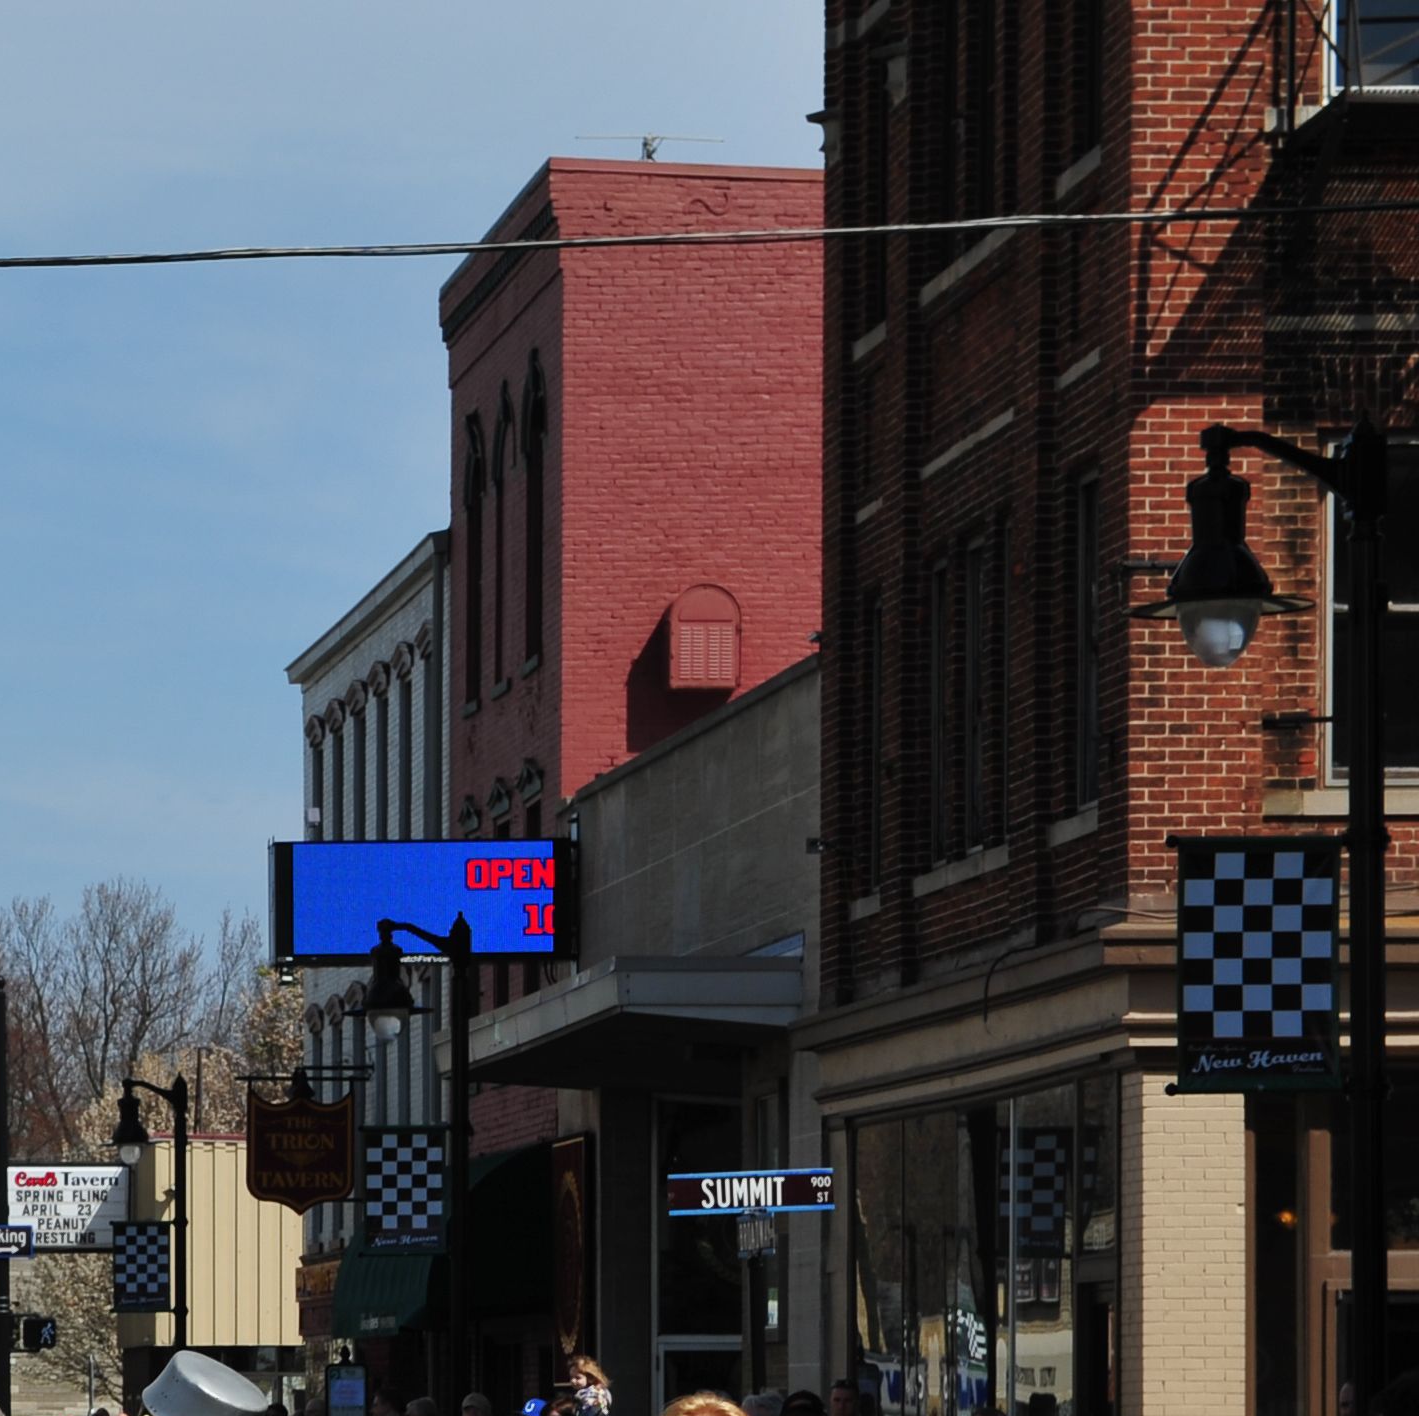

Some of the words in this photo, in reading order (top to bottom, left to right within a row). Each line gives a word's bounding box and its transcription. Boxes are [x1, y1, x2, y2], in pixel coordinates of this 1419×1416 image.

[466, 858, 555, 890] OPEN
[1192, 1054, 1244, 1073] New
[1246, 1050, 1325, 1070] Haven
[267, 1132, 337, 1150] TRION
[61, 1170, 120, 1187] Tavern
[256, 1171, 344, 1188] TAVERN
[810, 1176, 832, 1188] 900
[16, 1190, 63, 1203] SPRING
[72, 1190, 108, 1203] FLING
[700, 1176, 786, 1209] SUMMIT
[816, 1191, 829, 1203] ST
[22, 1204, 61, 1217] APRIL
[77, 1204, 92, 1216] 23
[37, 1217, 87, 1230] PEANUT
[35, 1231, 96, 1244] RESTLING
[371, 1237, 398, 1247] New
[399, 1234, 439, 1244] Haven
